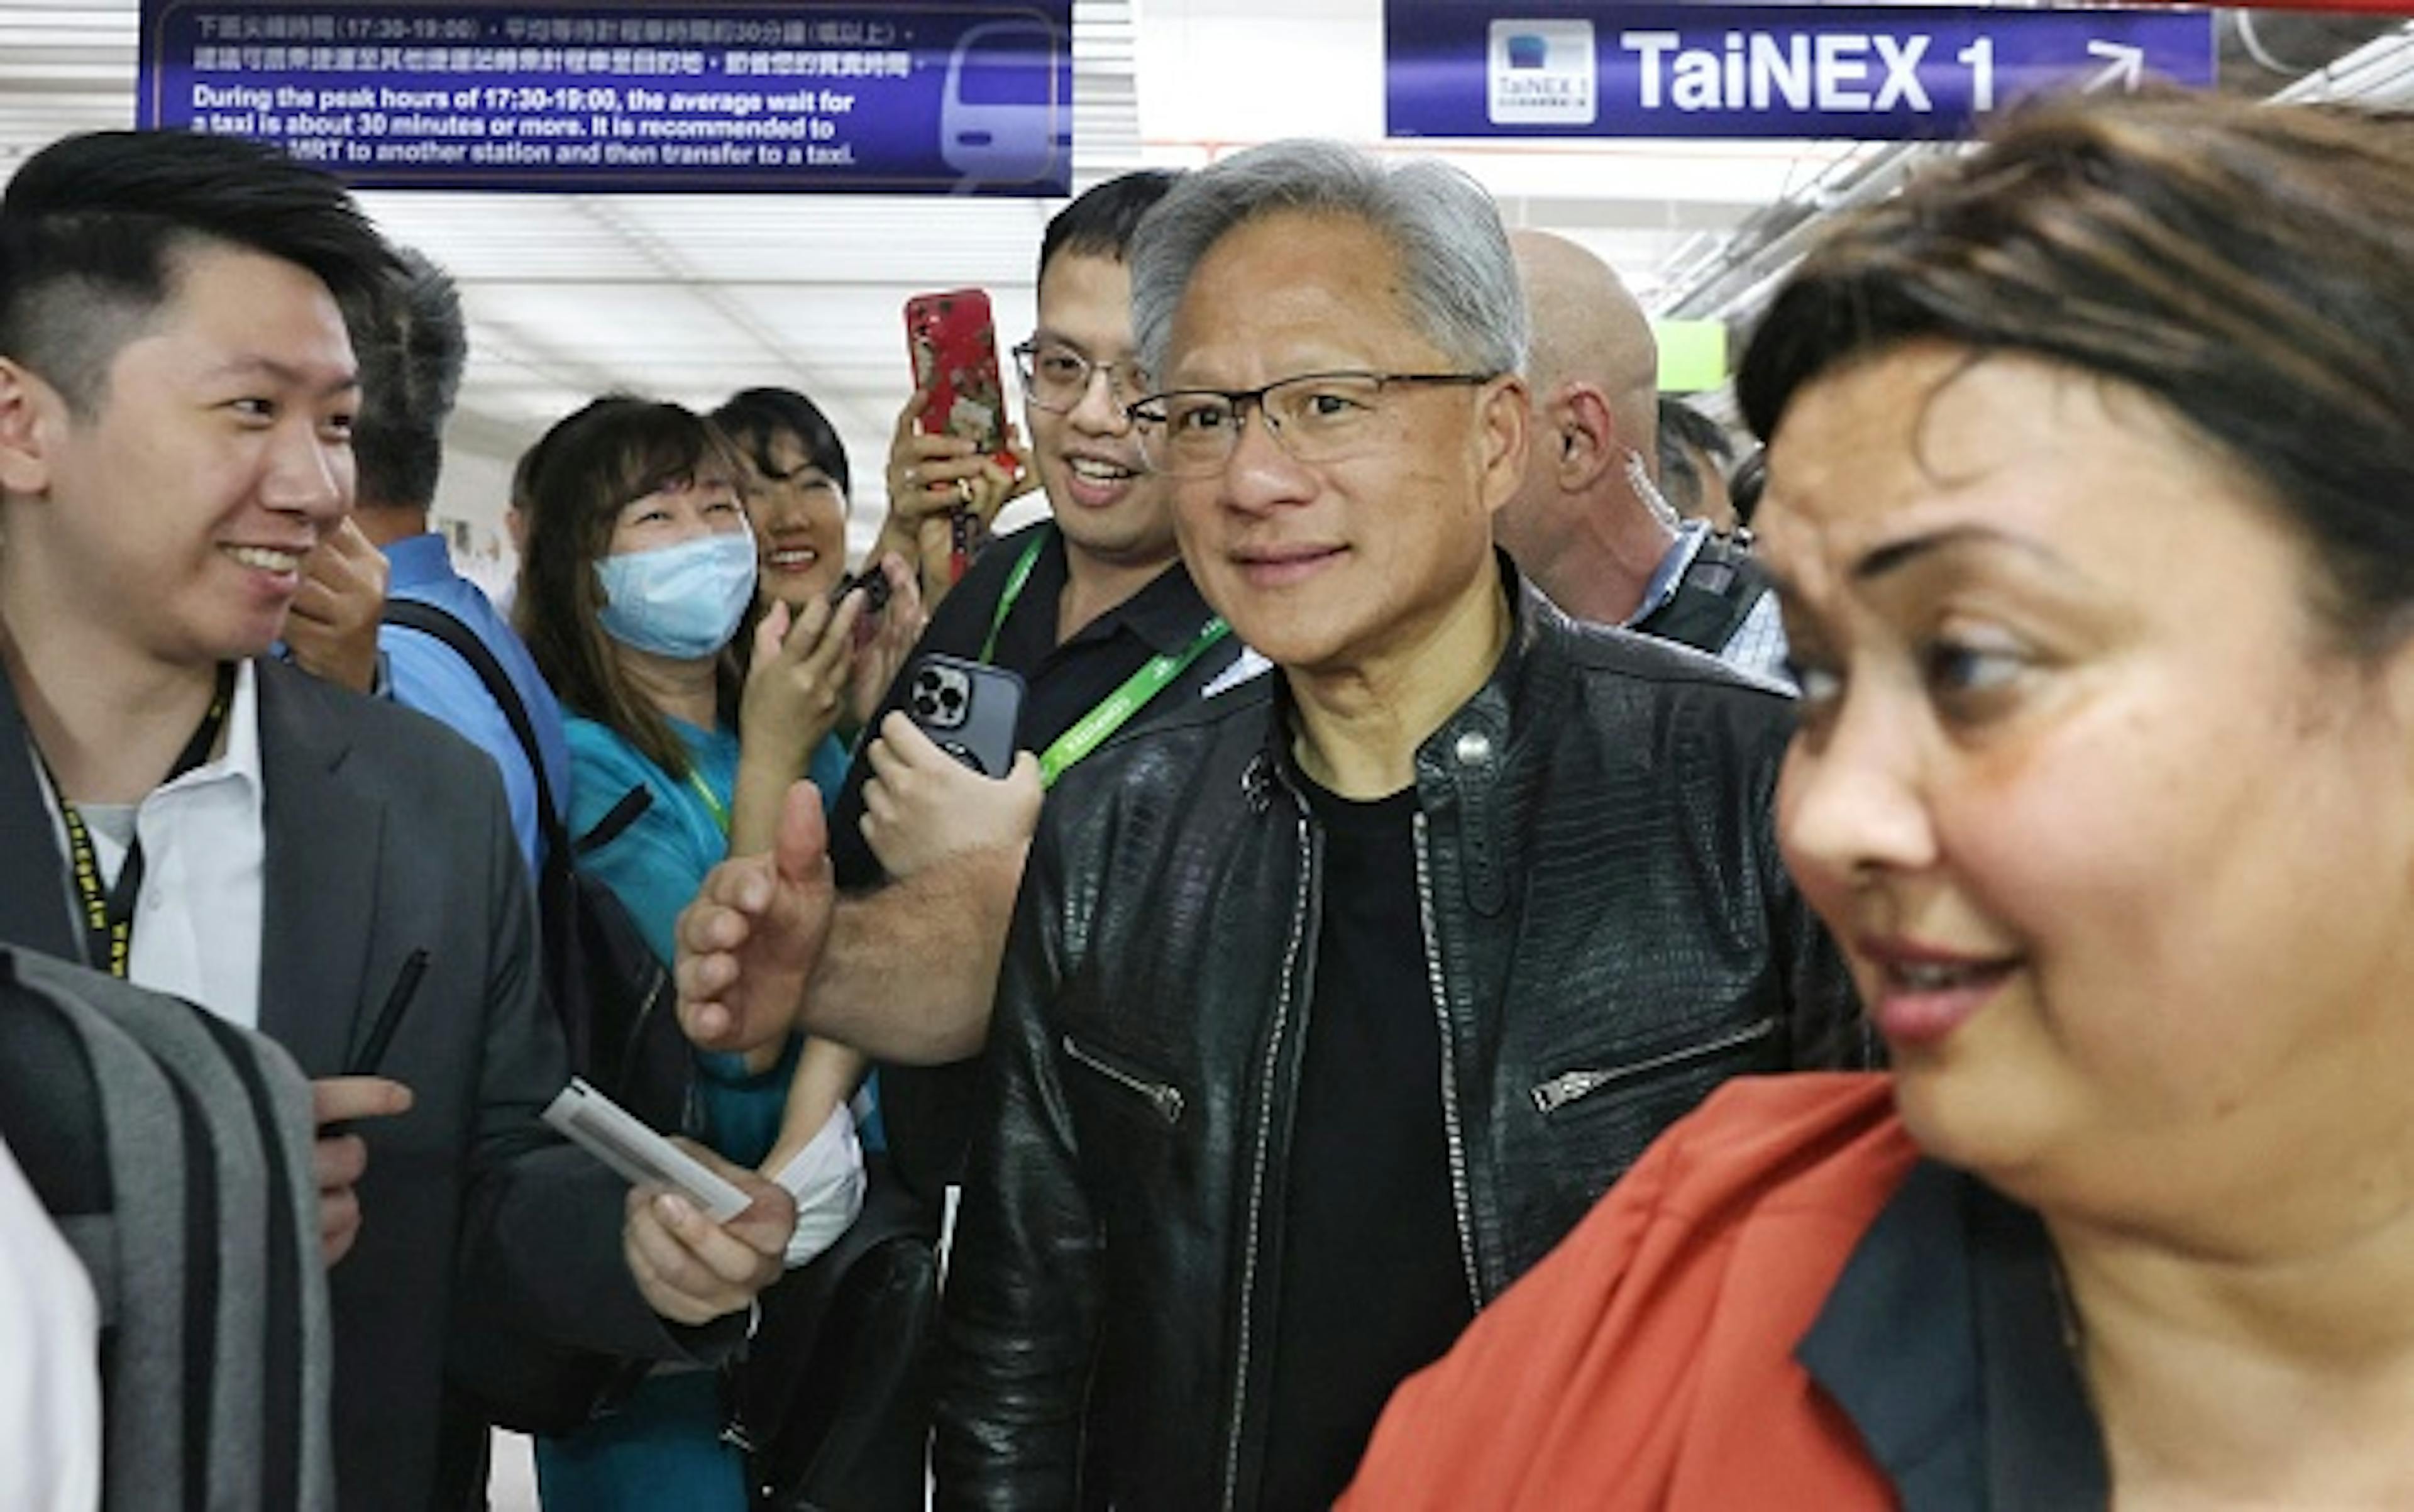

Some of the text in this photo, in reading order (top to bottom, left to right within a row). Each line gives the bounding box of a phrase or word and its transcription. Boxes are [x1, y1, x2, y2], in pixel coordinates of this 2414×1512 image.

[1620, 31, 1994, 112] TaiNEX 1
[193, 84, 854, 116] During the peak hours of 17:30-19:00, the average wait for
[191, 111, 835, 139] a taxi is about 30 minutes or more. It is recommended to
[346, 140, 372, 161] to
[376, 140, 467, 163] another
[470, 141, 551, 163] station
[554, 141, 600, 164] and
[604, 142, 658, 164] then
[661, 143, 753, 165] transfer
[758, 145, 783, 165] to
[786, 148, 802, 165] a
[805, 144, 855, 165] taxi.
